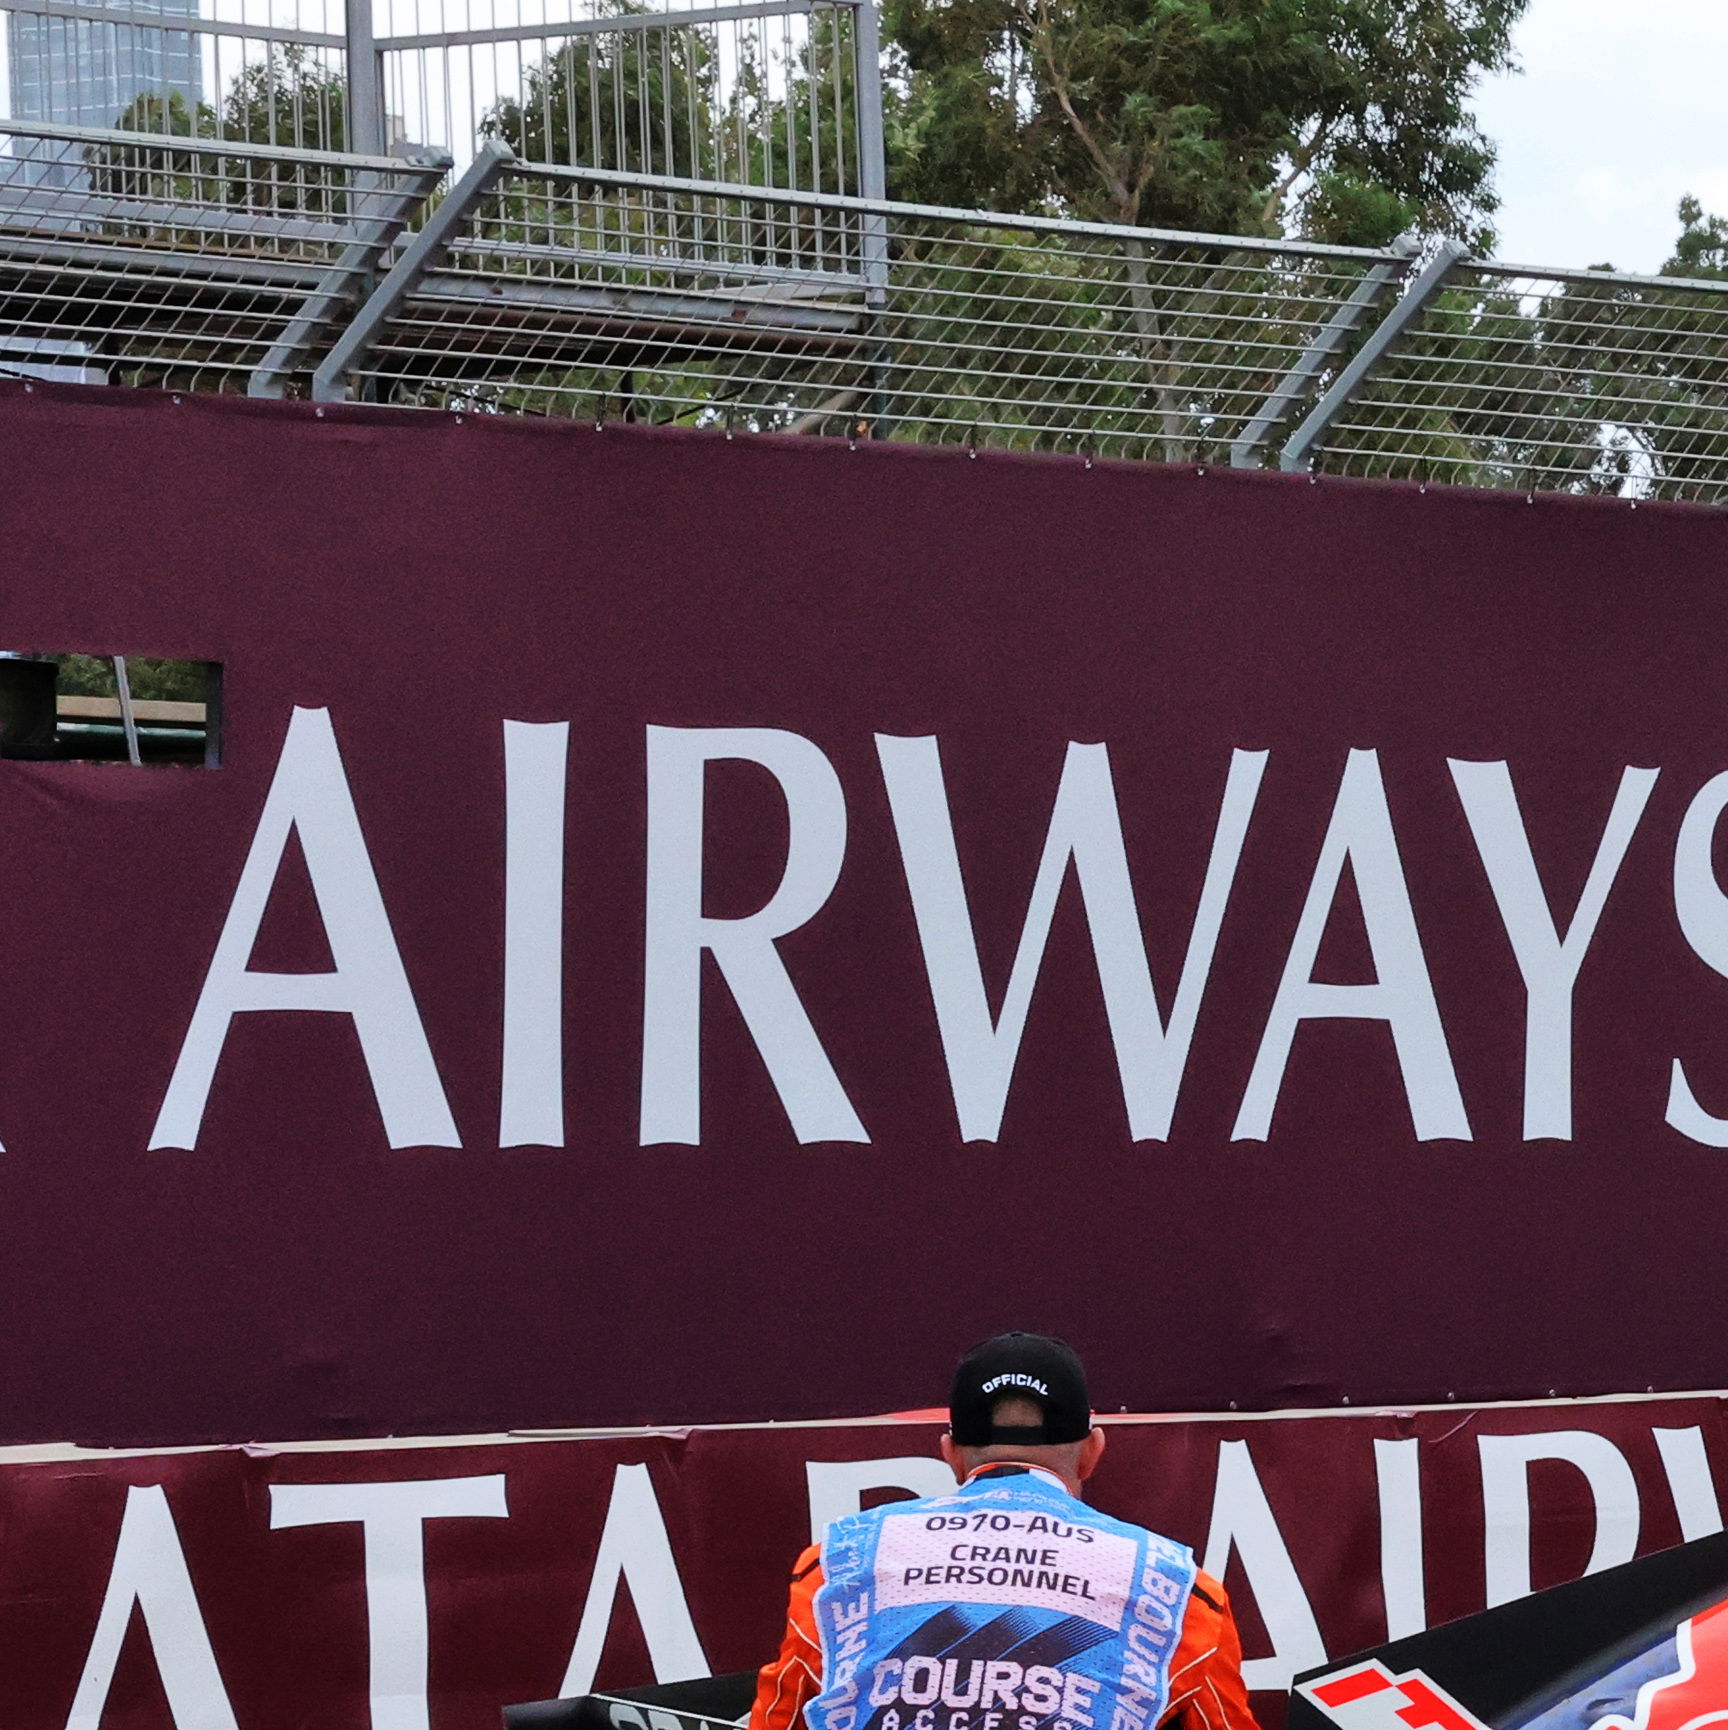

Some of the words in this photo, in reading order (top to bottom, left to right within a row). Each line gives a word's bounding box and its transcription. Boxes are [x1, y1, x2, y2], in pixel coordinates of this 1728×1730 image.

[981, 1373, 1049, 1396] OFFICIAL
[925, 1513, 1096, 1544] 0970-AUS
[950, 1544, 1060, 1568] CRANE
[903, 1565, 1097, 1602] PERSONNEL
[868, 1655, 1100, 1729] COURSE
